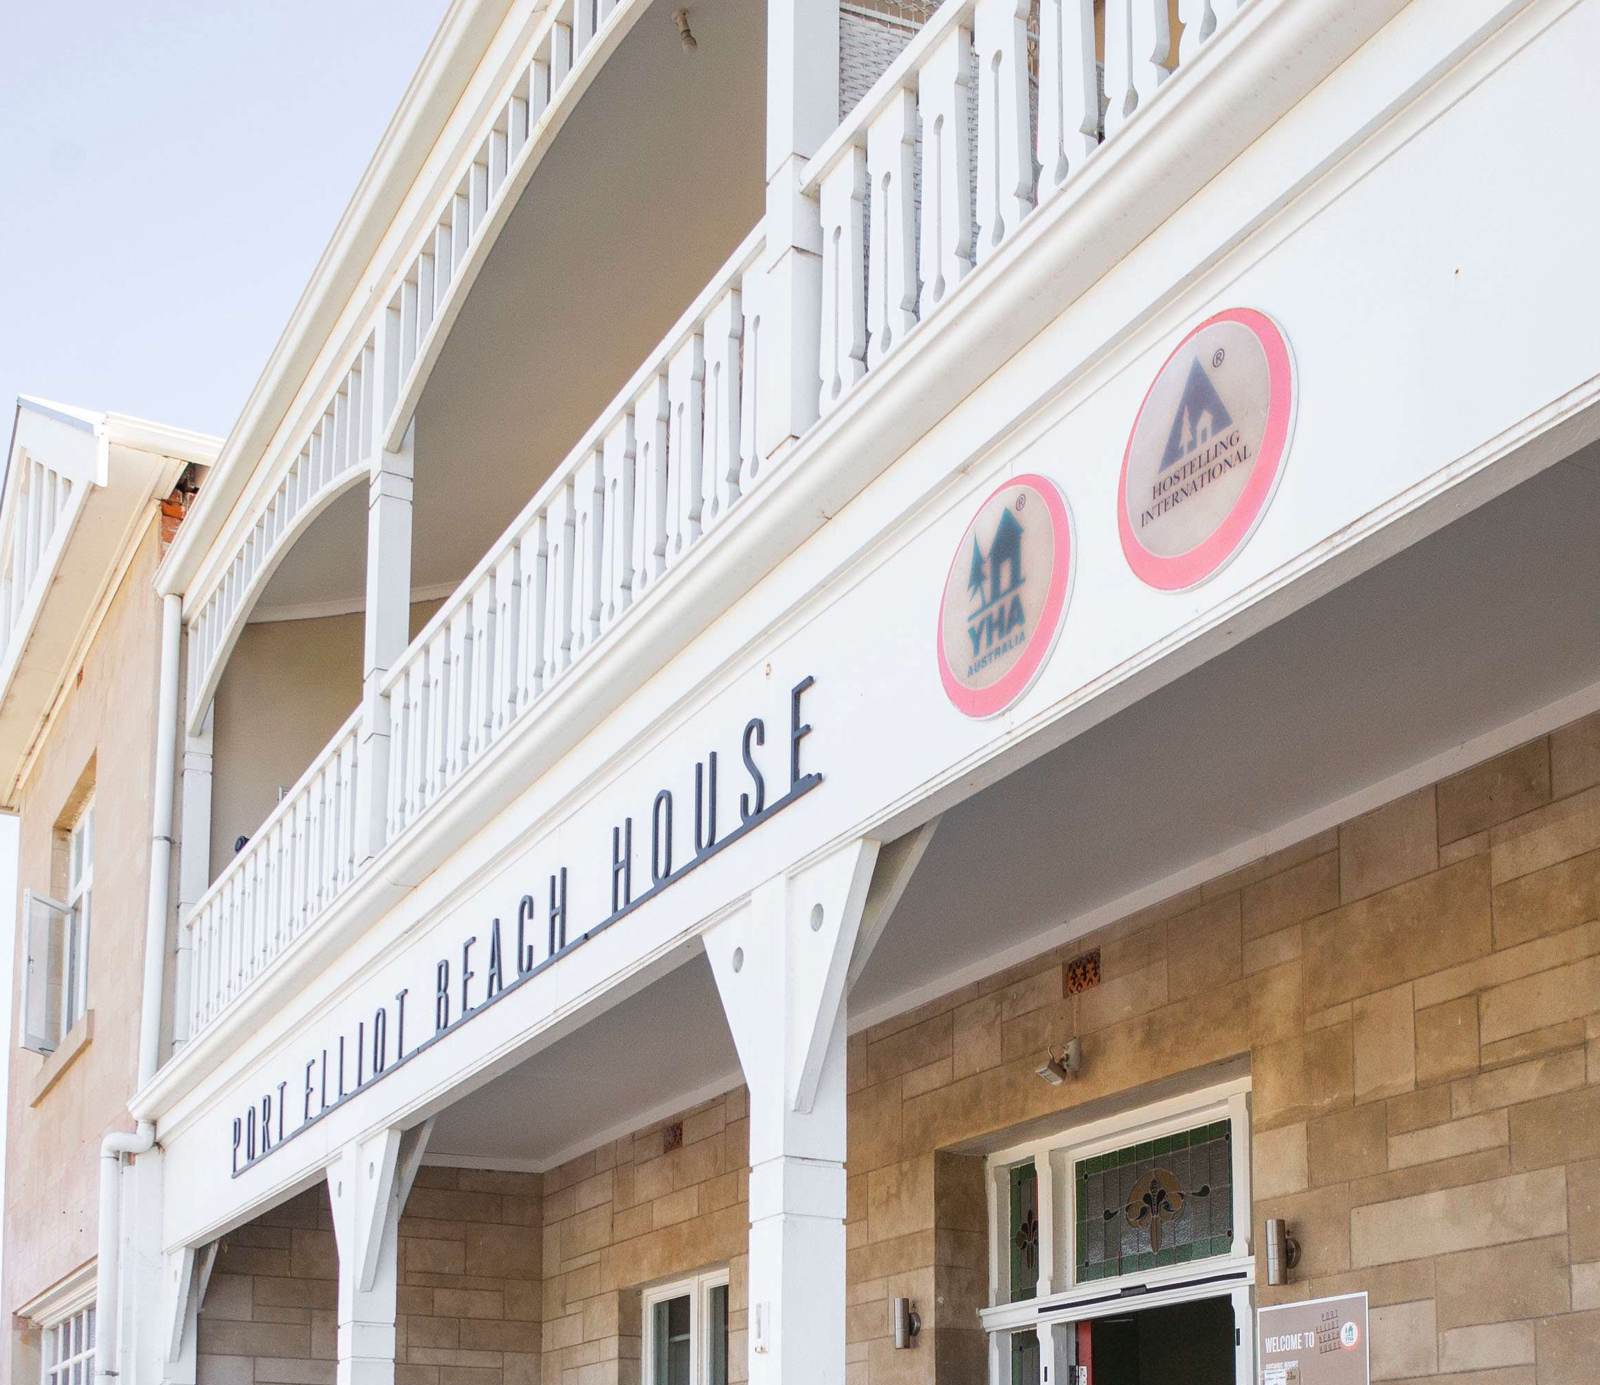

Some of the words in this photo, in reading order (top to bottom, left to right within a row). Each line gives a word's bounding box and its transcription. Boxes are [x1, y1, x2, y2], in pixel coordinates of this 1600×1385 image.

[1140, 445, 1252, 529] INTERNATIONAL
[1152, 430, 1241, 501] HOSTELLING
[967, 594, 1026, 657] YHA
[967, 631, 1027, 678] AUSTRALIA
[231, 1080, 289, 1177] PORT
[304, 988, 408, 1122] ELLIOT
[436, 866, 568, 1032] BEACH
[612, 675, 822, 916] HOUSE
[1265, 1333, 1302, 1353] WELCOME
[1304, 1331, 1315, 1348] TO
